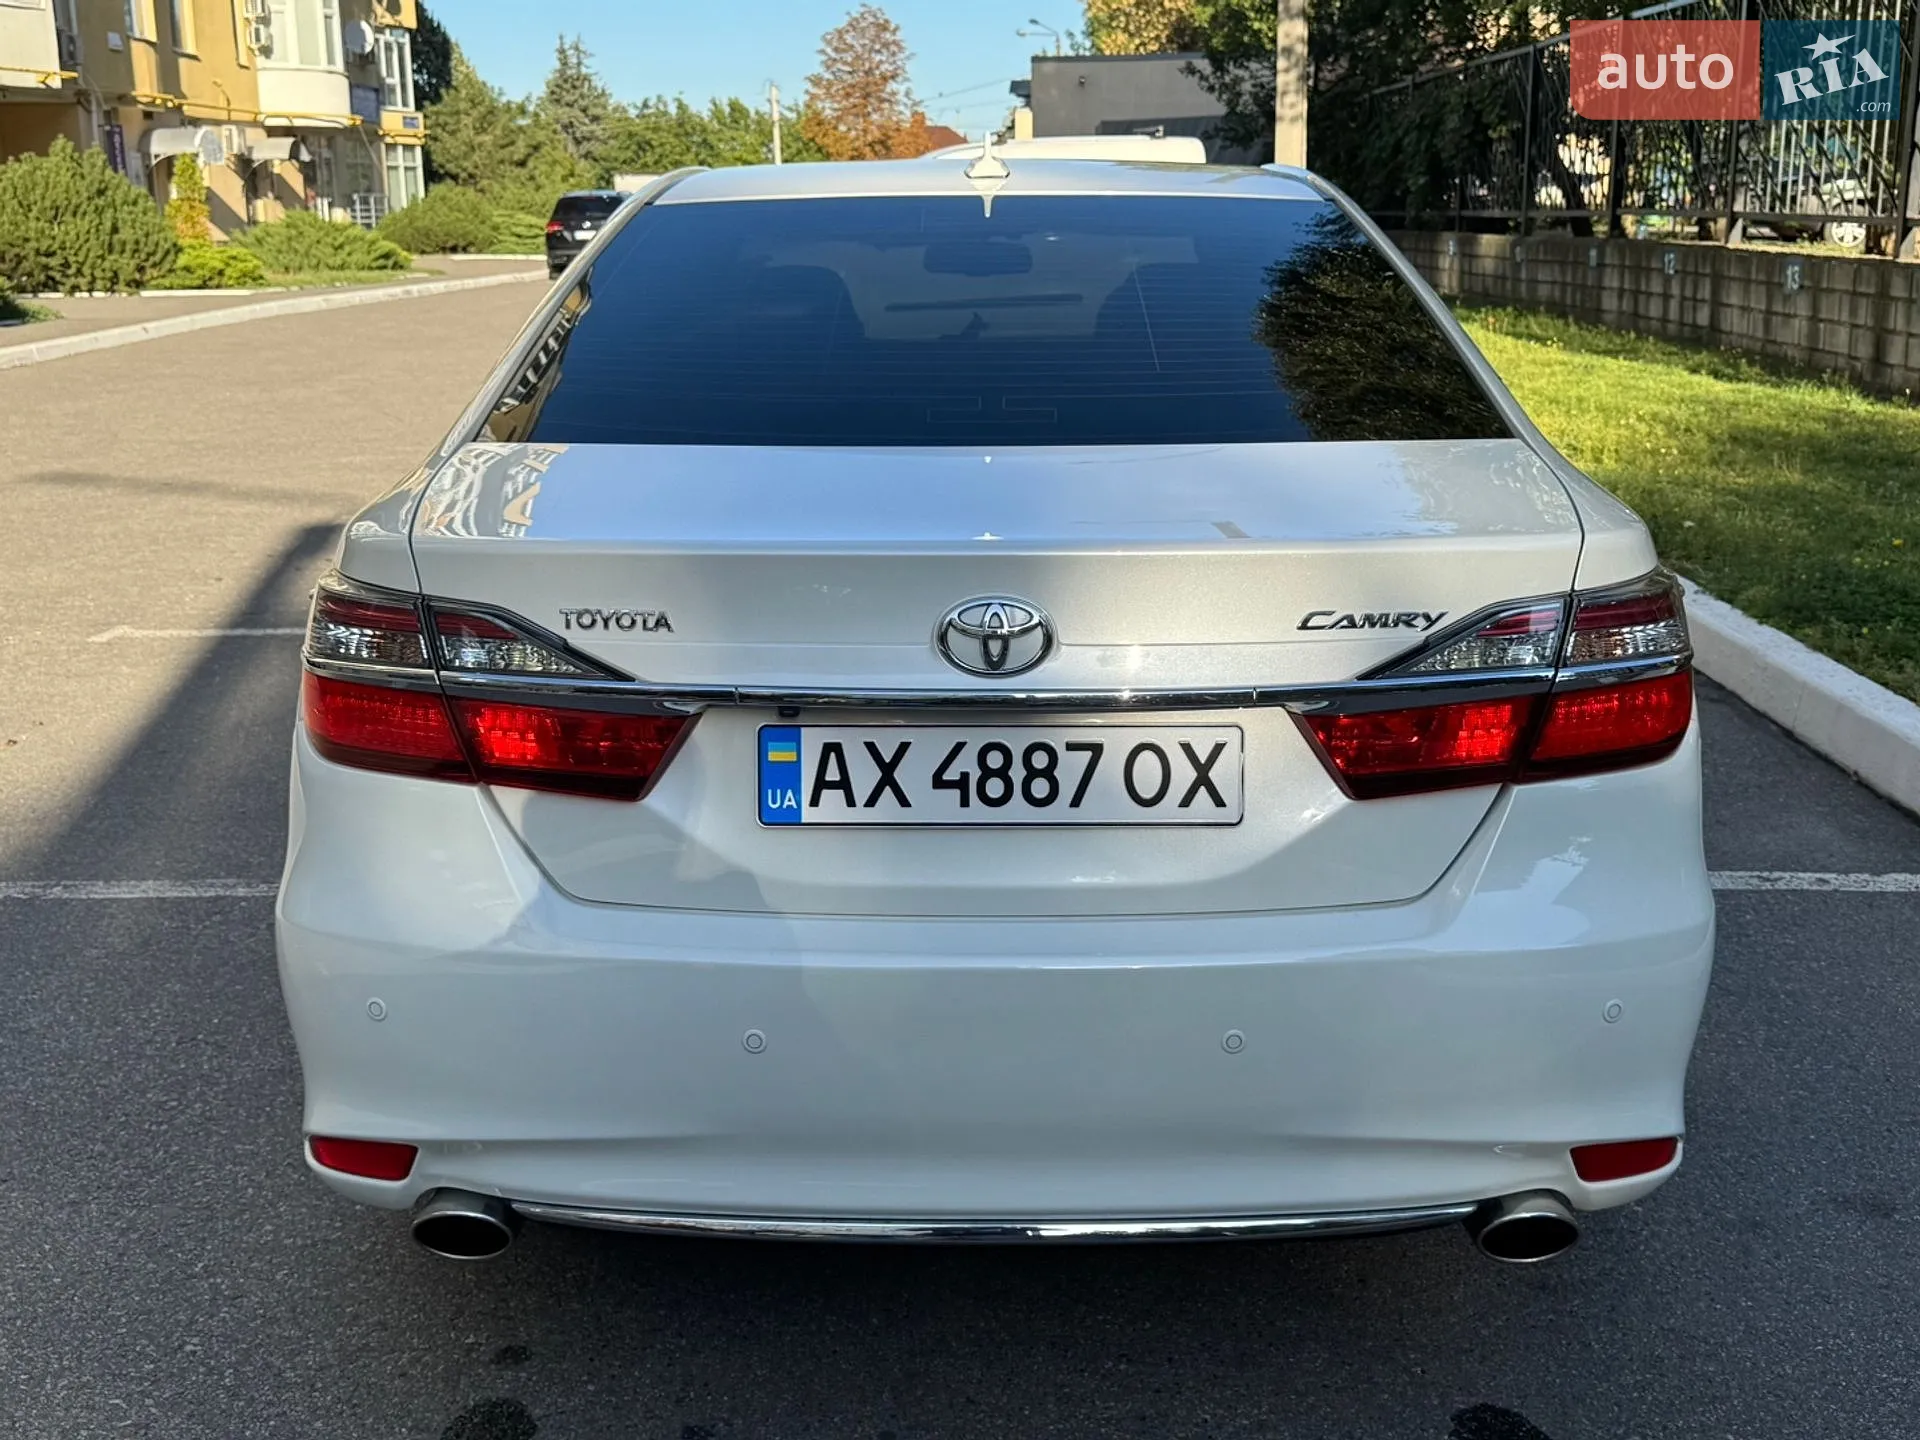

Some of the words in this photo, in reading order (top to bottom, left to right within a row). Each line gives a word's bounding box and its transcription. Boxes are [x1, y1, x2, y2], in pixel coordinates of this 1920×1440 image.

[1786, 264, 1800, 290] 13
[559, 608, 674, 633] TOYOTA
[1296, 610, 1449, 632] CAMRY
[808, 741, 912, 808] AX
[931, 740, 1104, 808] 4887
[1123, 740, 1228, 808] OX
[767, 790, 797, 809] UA
